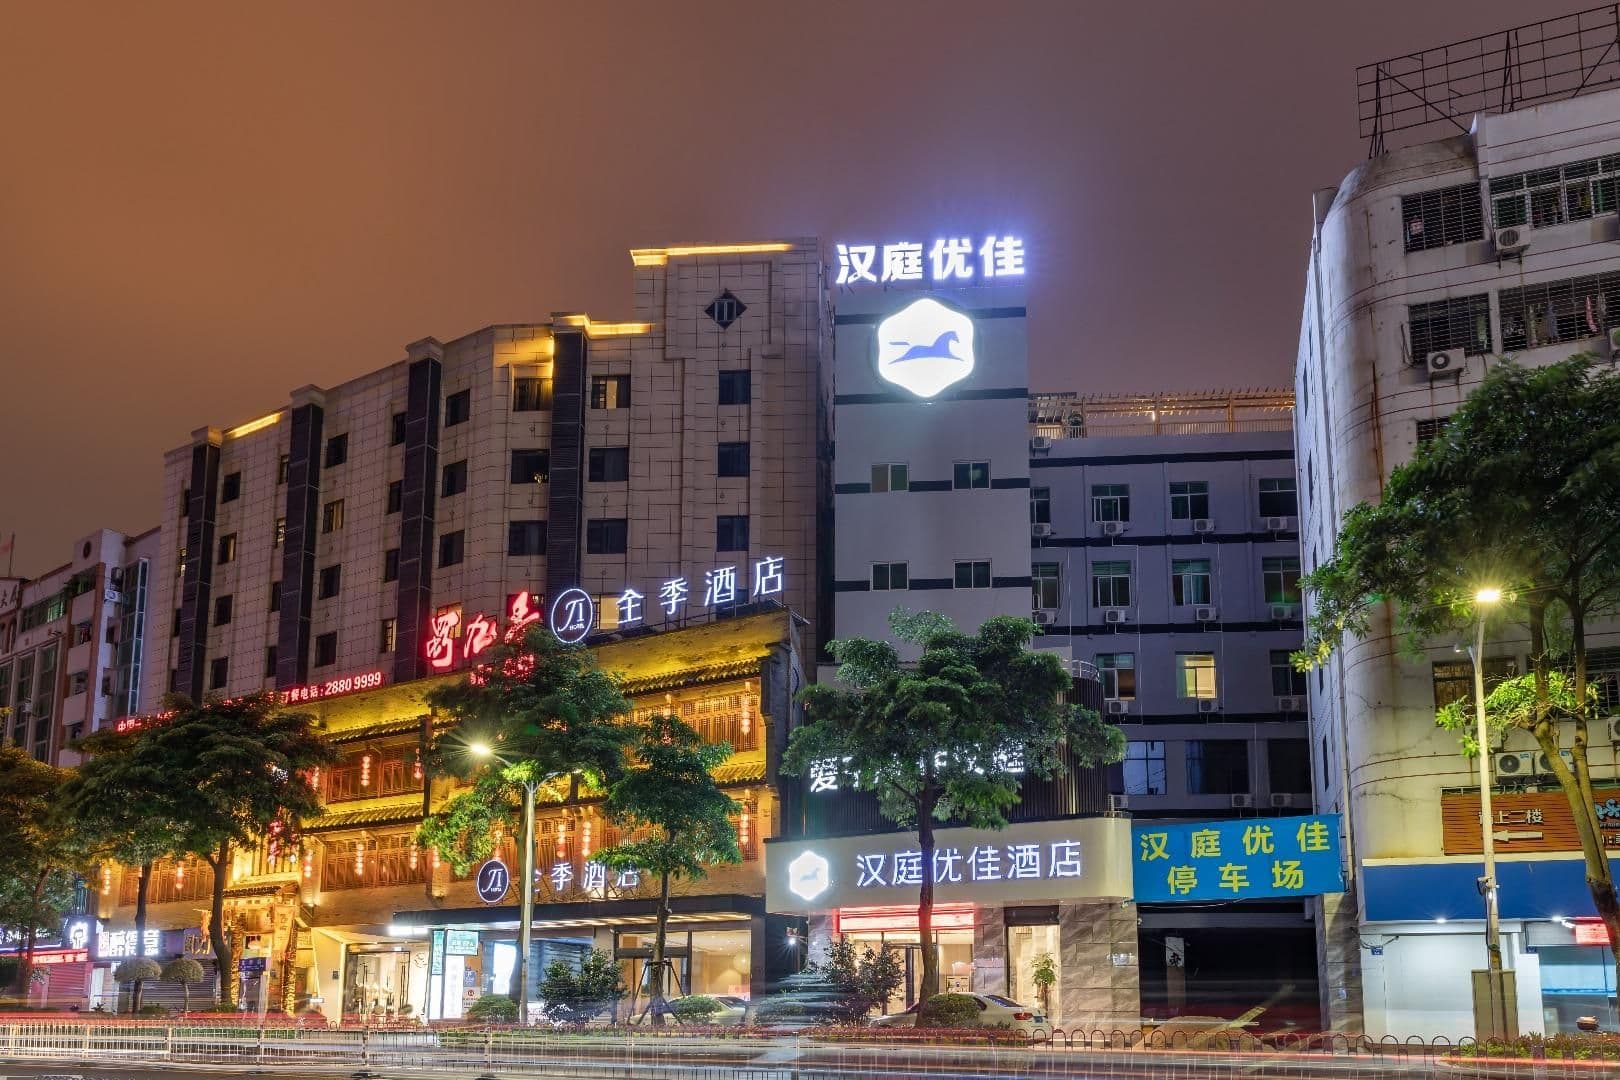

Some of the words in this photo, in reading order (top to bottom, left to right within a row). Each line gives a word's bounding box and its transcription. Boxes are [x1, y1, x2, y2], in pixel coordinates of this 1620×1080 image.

[835, 235, 1026, 284] 汉庭优佳
[616, 556, 784, 624] 全季酒店
[353, 671, 382, 690] 9999
[1140, 821, 1331, 861] 汉庭优佳
[856, 839, 1082, 888] 汉庭优佳酒店
[1167, 860, 1304, 895] 停车场
